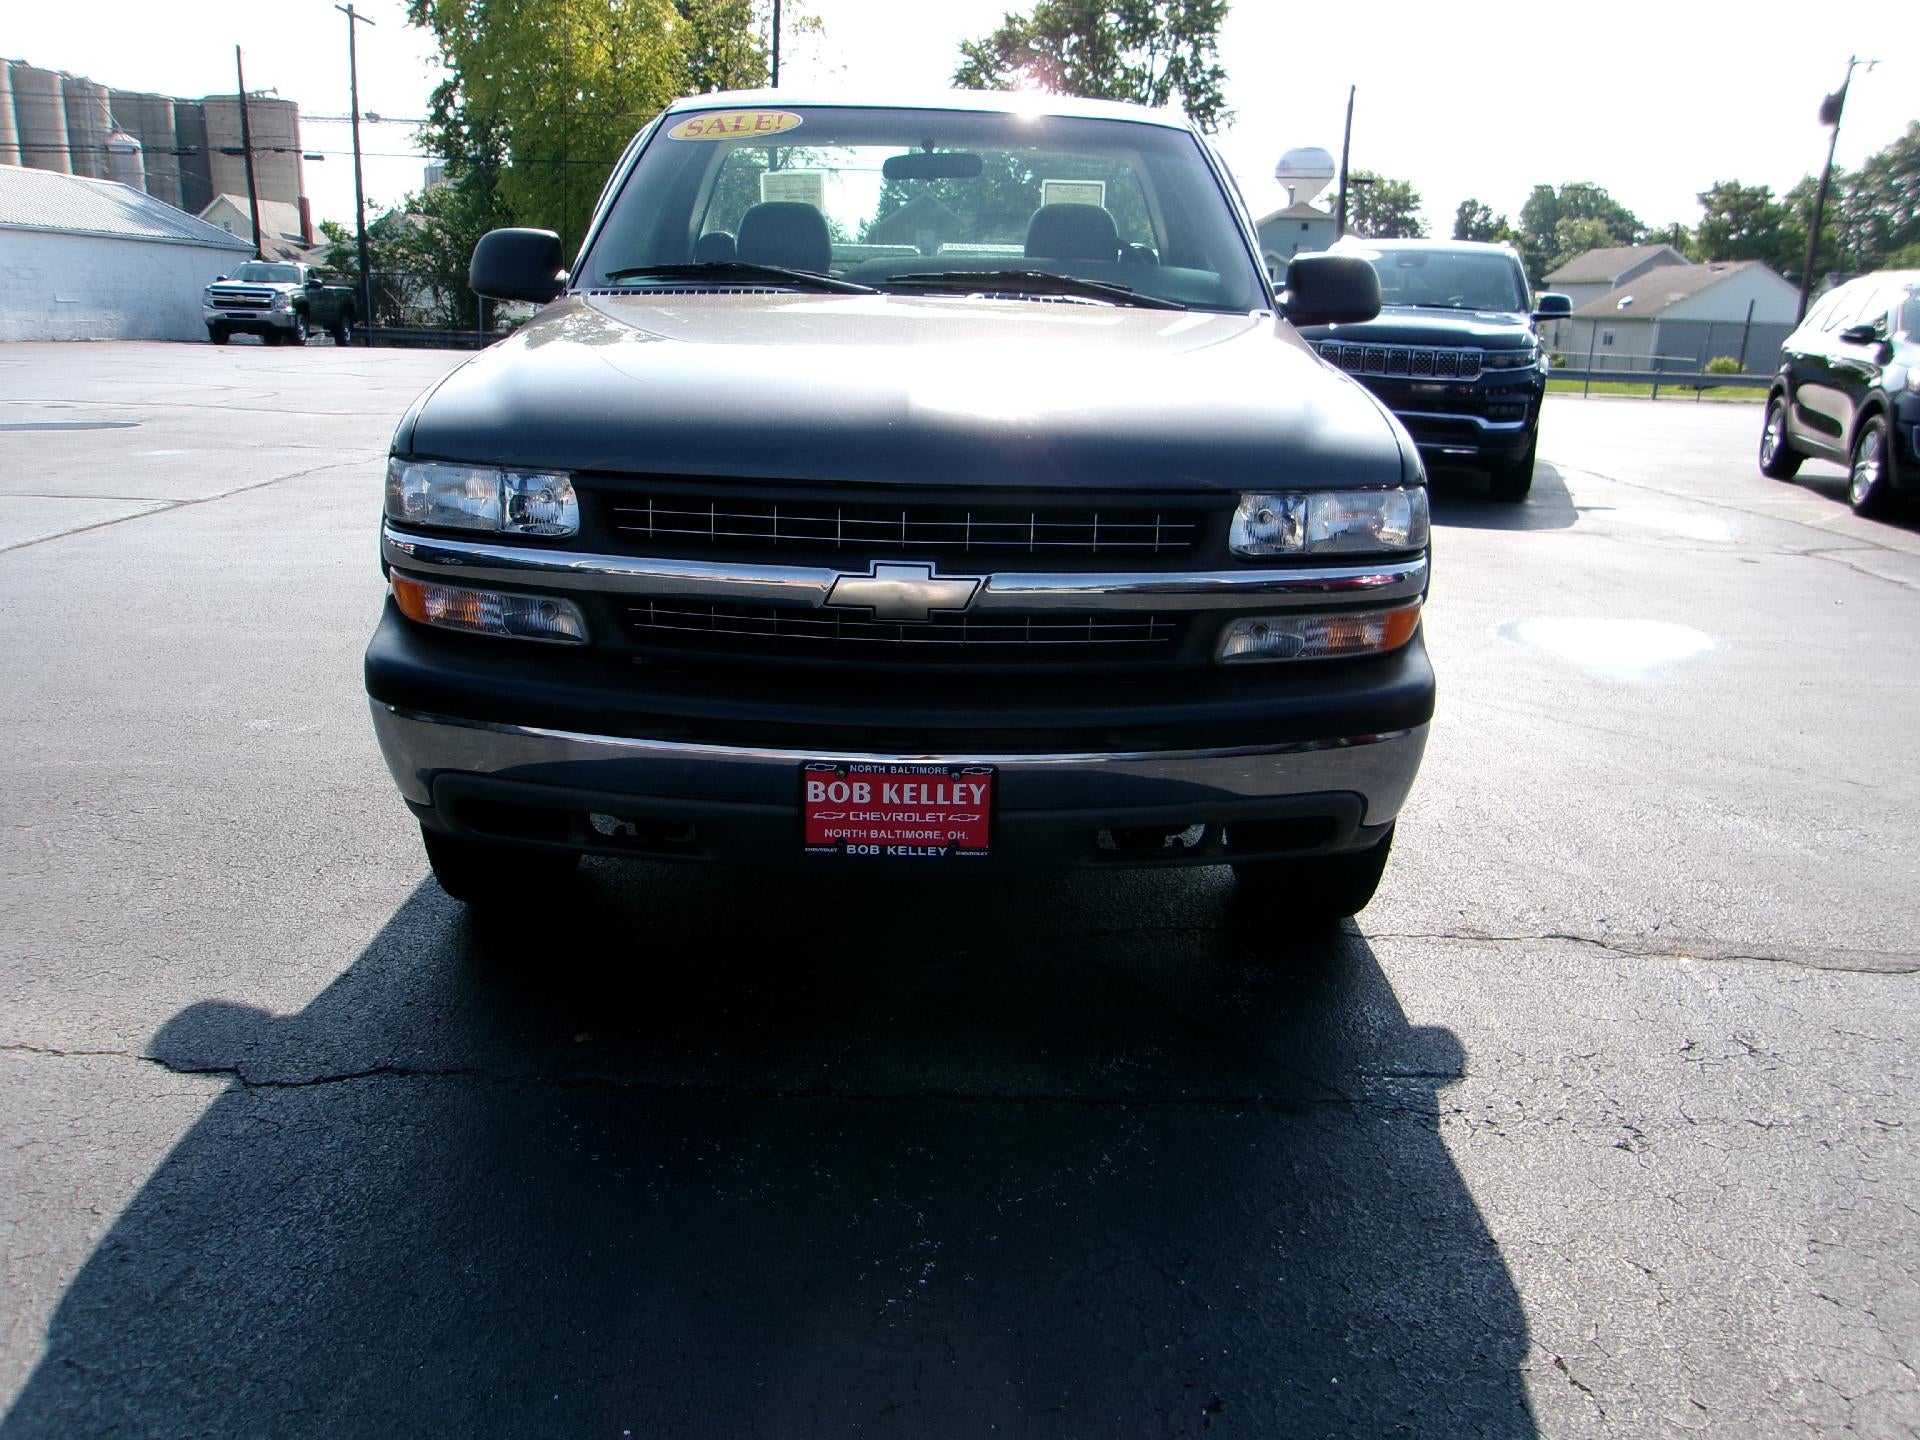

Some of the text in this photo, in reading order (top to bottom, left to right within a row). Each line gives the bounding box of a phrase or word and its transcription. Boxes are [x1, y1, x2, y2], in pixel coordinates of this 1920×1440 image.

[685, 114, 784, 137] SALE!
[850, 765, 949, 775] NORTH BALTIMORE
[807, 780, 986, 805] BOB KELLEY
[849, 811, 947, 822] CHEVROLET
[824, 828, 969, 840] NORTH BALTIMORE, OH.
[846, 845, 948, 856] BOB KELLEY
